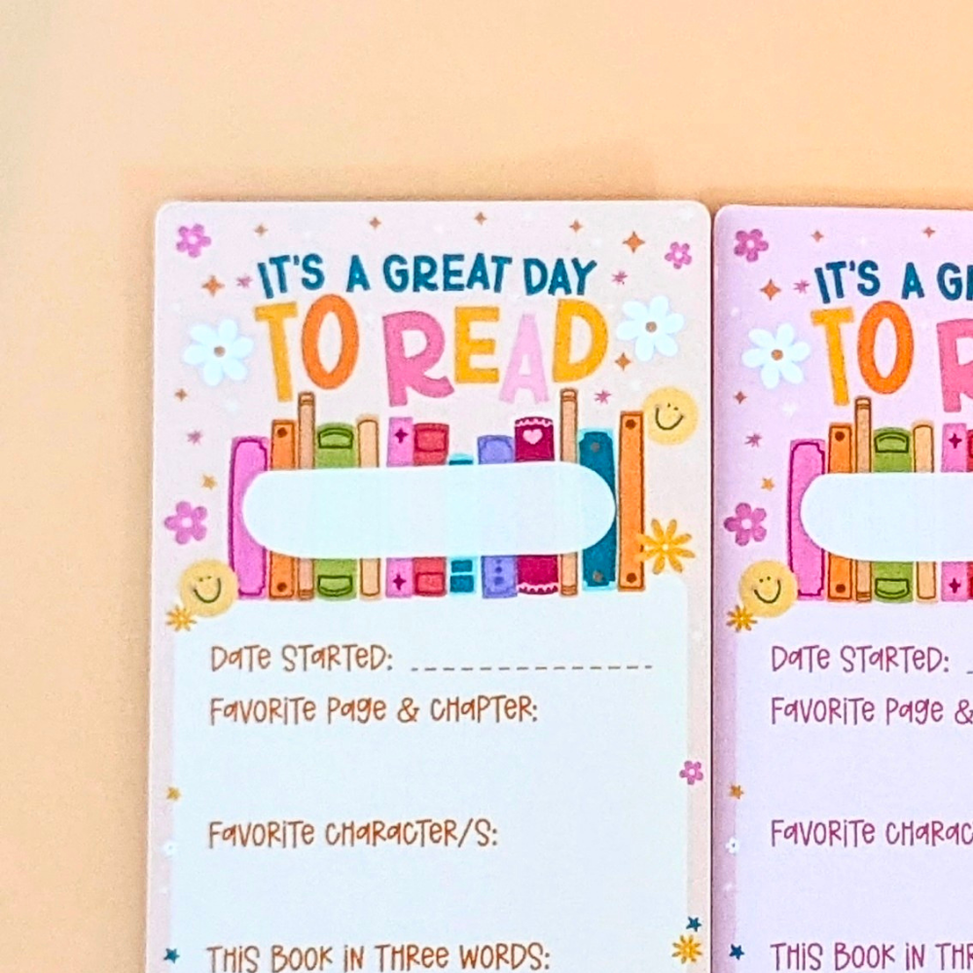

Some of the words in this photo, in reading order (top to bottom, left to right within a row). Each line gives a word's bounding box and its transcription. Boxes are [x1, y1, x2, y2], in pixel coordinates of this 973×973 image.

[257, 253, 325, 300] IT'S
[345, 254, 371, 293] A
[382, 252, 513, 293] GREAT
[523, 257, 598, 296] DAY
[814, 259, 881, 305] IT'S
[901, 261, 925, 300] A
[254, 293, 360, 402] TO
[382, 298, 609, 407] READ
[810, 300, 915, 407] TO
[210, 643, 272, 673] DaTe
[280, 643, 394, 673] STaRTeD:
[771, 644, 831, 674] DaTe
[839, 644, 950, 675] STaRTeD:
[209, 696, 317, 727] FaVORiTe
[326, 695, 388, 726] Page
[396, 696, 421, 724] &
[429, 694, 538, 724] CHaPTeR:
[771, 696, 876, 726] FaVORiTe
[885, 696, 944, 727] Page
[208, 819, 316, 850] FaVORiTe
[324, 817, 498, 849] CHaRaCTeR/S:
[770, 818, 876, 849] FaVORiTe
[342, 943, 365, 973] iN
[373, 943, 450, 973] THRee
[458, 941, 551, 972] WORDS:
[769, 941, 824, 972] THiS
[833, 941, 896, 972] BOOK
[904, 941, 926, 972] iN
